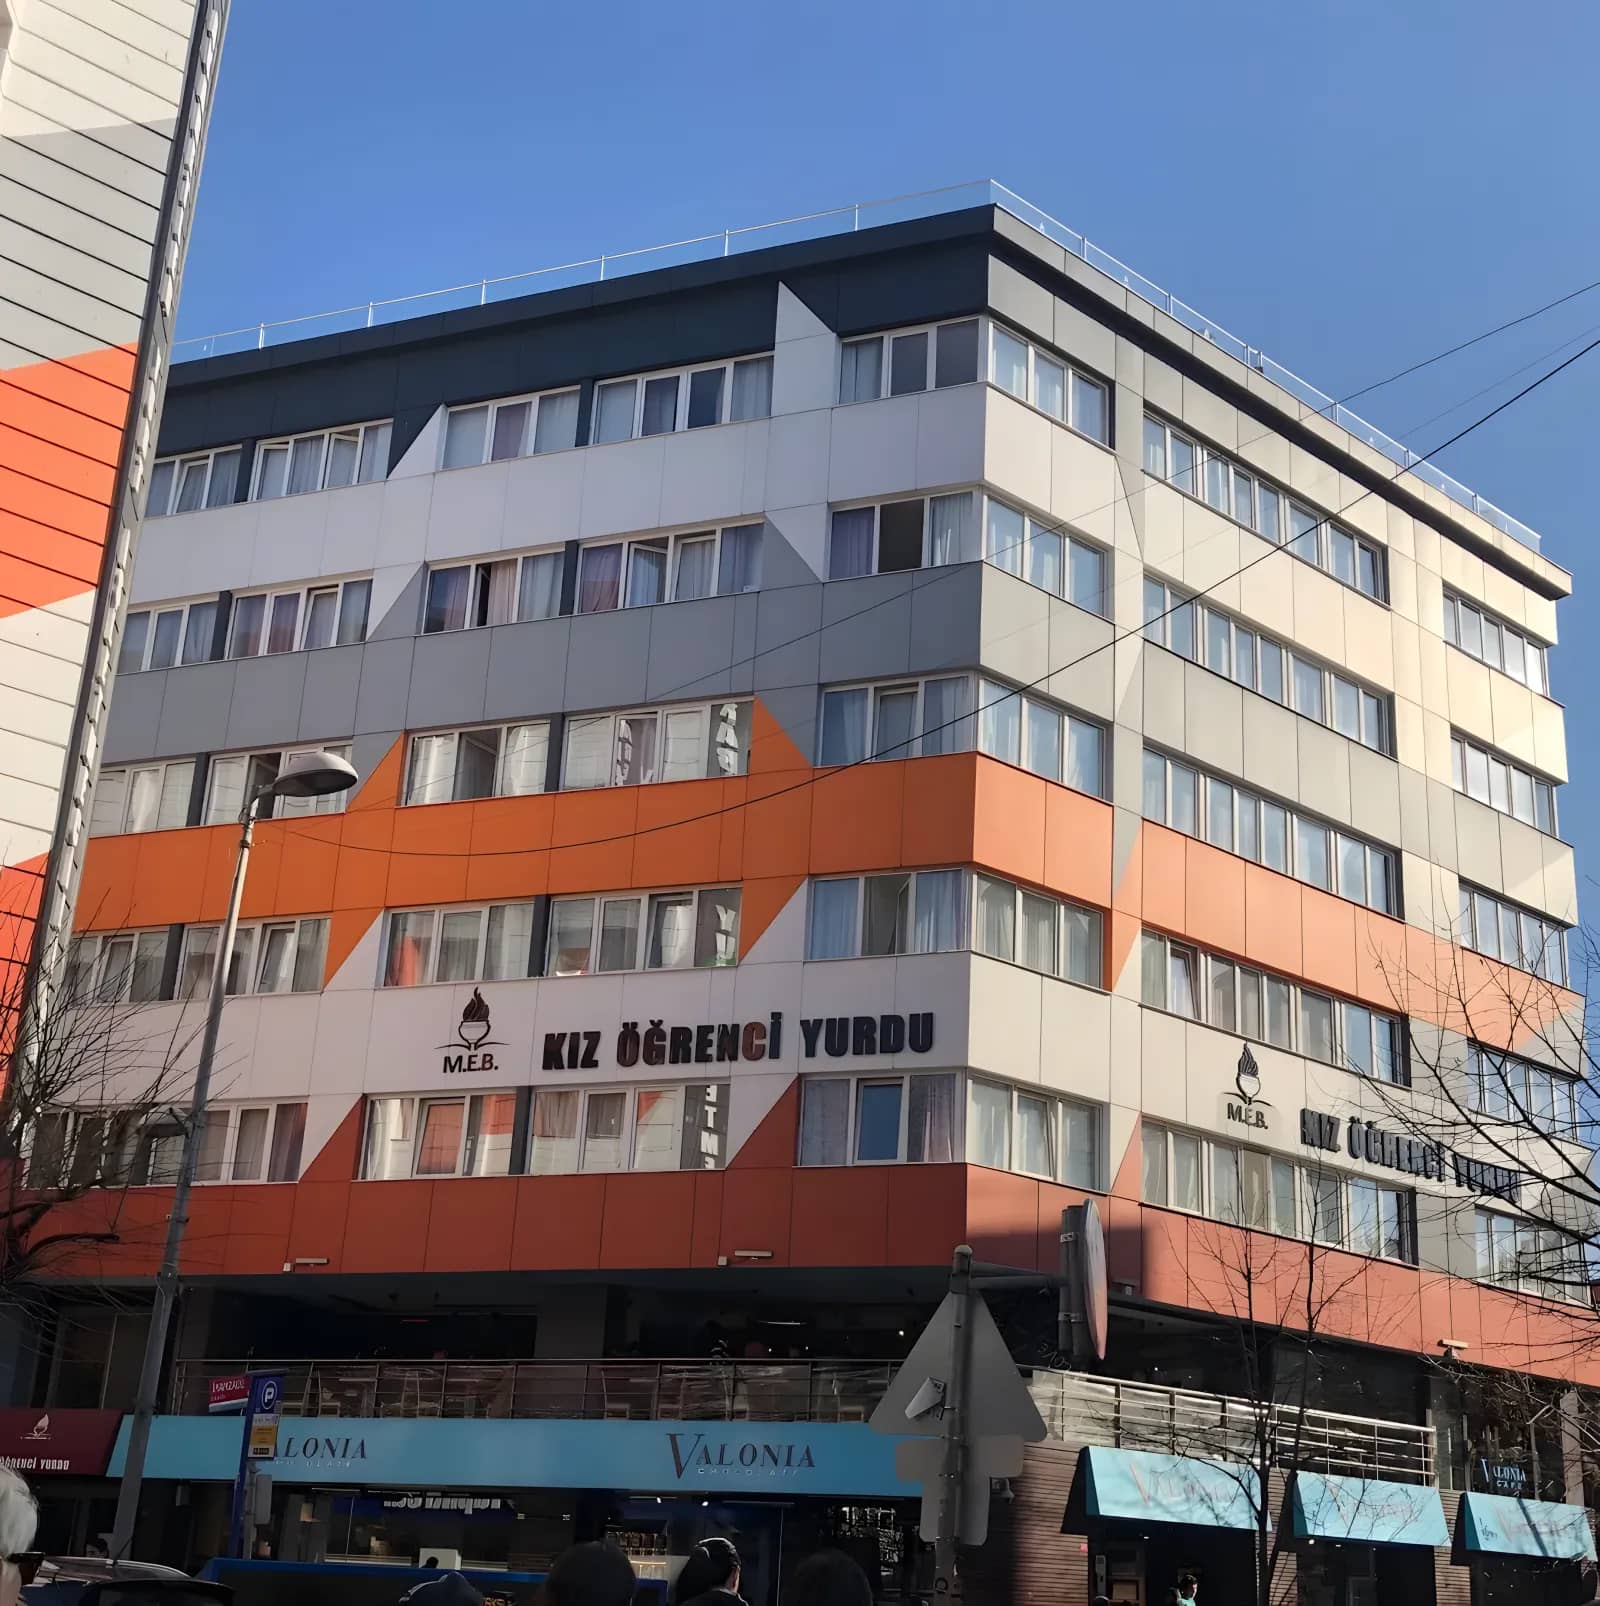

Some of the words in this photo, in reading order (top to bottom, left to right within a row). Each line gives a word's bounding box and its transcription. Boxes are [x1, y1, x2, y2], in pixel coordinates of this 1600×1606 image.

[542, 1031, 601, 1071] KIZ
[617, 1012, 783, 1067] ÖĞRENCİ
[800, 1012, 934, 1058] YURDU
[442, 1053, 500, 1074] M.E.B.
[1227, 1102, 1269, 1130] M.E.B.
[274, 1436, 368, 1459] LONIA
[665, 1432, 816, 1479] VALONIA
